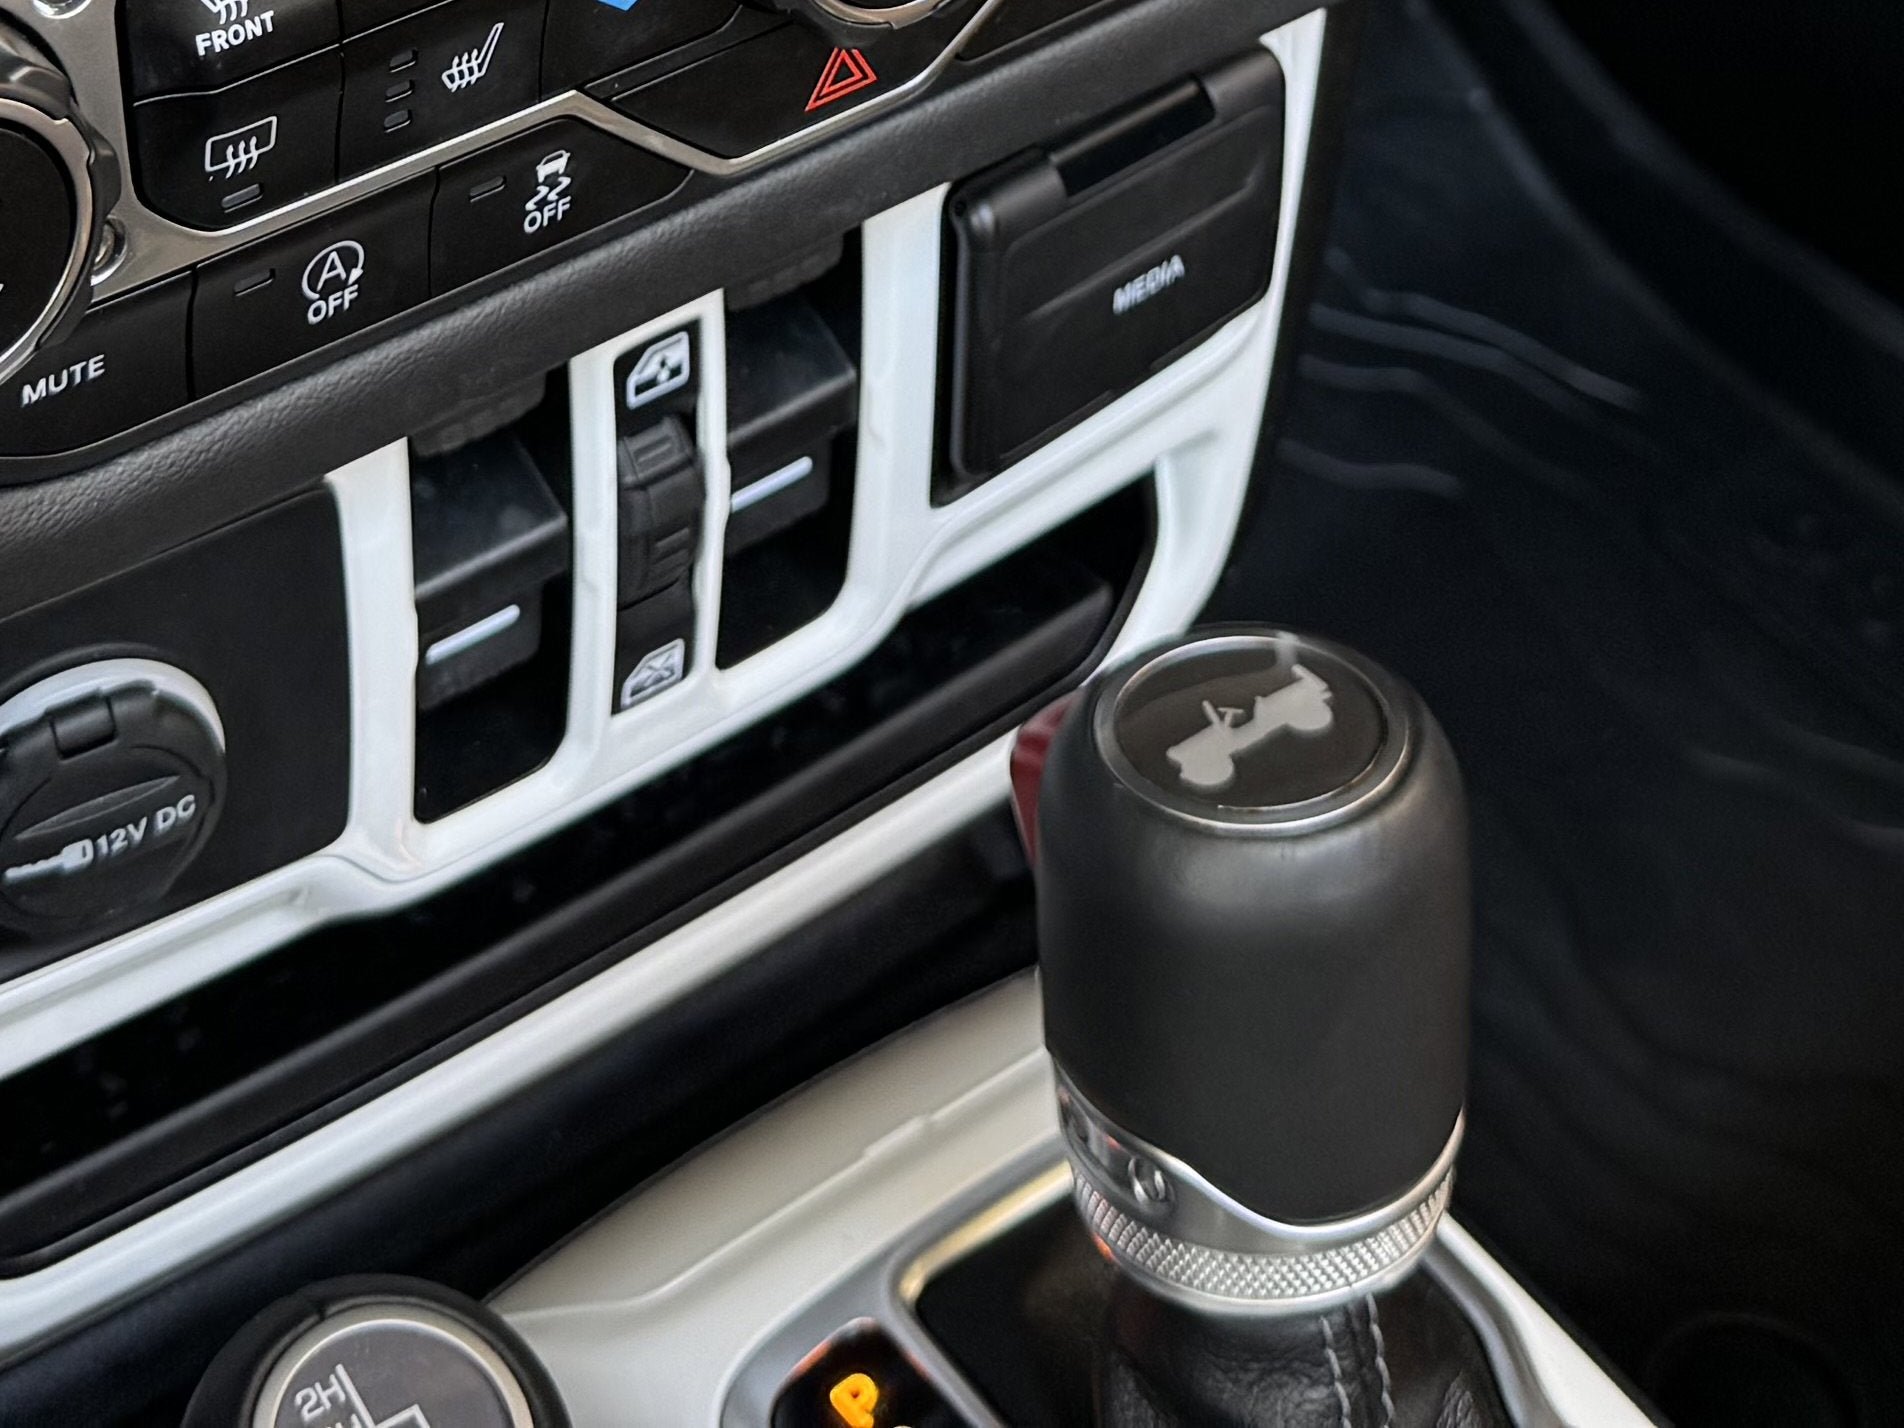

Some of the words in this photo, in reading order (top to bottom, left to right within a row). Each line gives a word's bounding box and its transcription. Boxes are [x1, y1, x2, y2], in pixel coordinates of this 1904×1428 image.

[196, 10, 275, 57] FRONT
[523, 194, 571, 234] OFF
[307, 286, 360, 325] OFF
[1111, 254, 1186, 314] MEDIA
[21, 354, 106, 407] MUTE
[96, 817, 148, 859] 12V
[155, 794, 197, 832] DC
[295, 1374, 346, 1422] 2H
